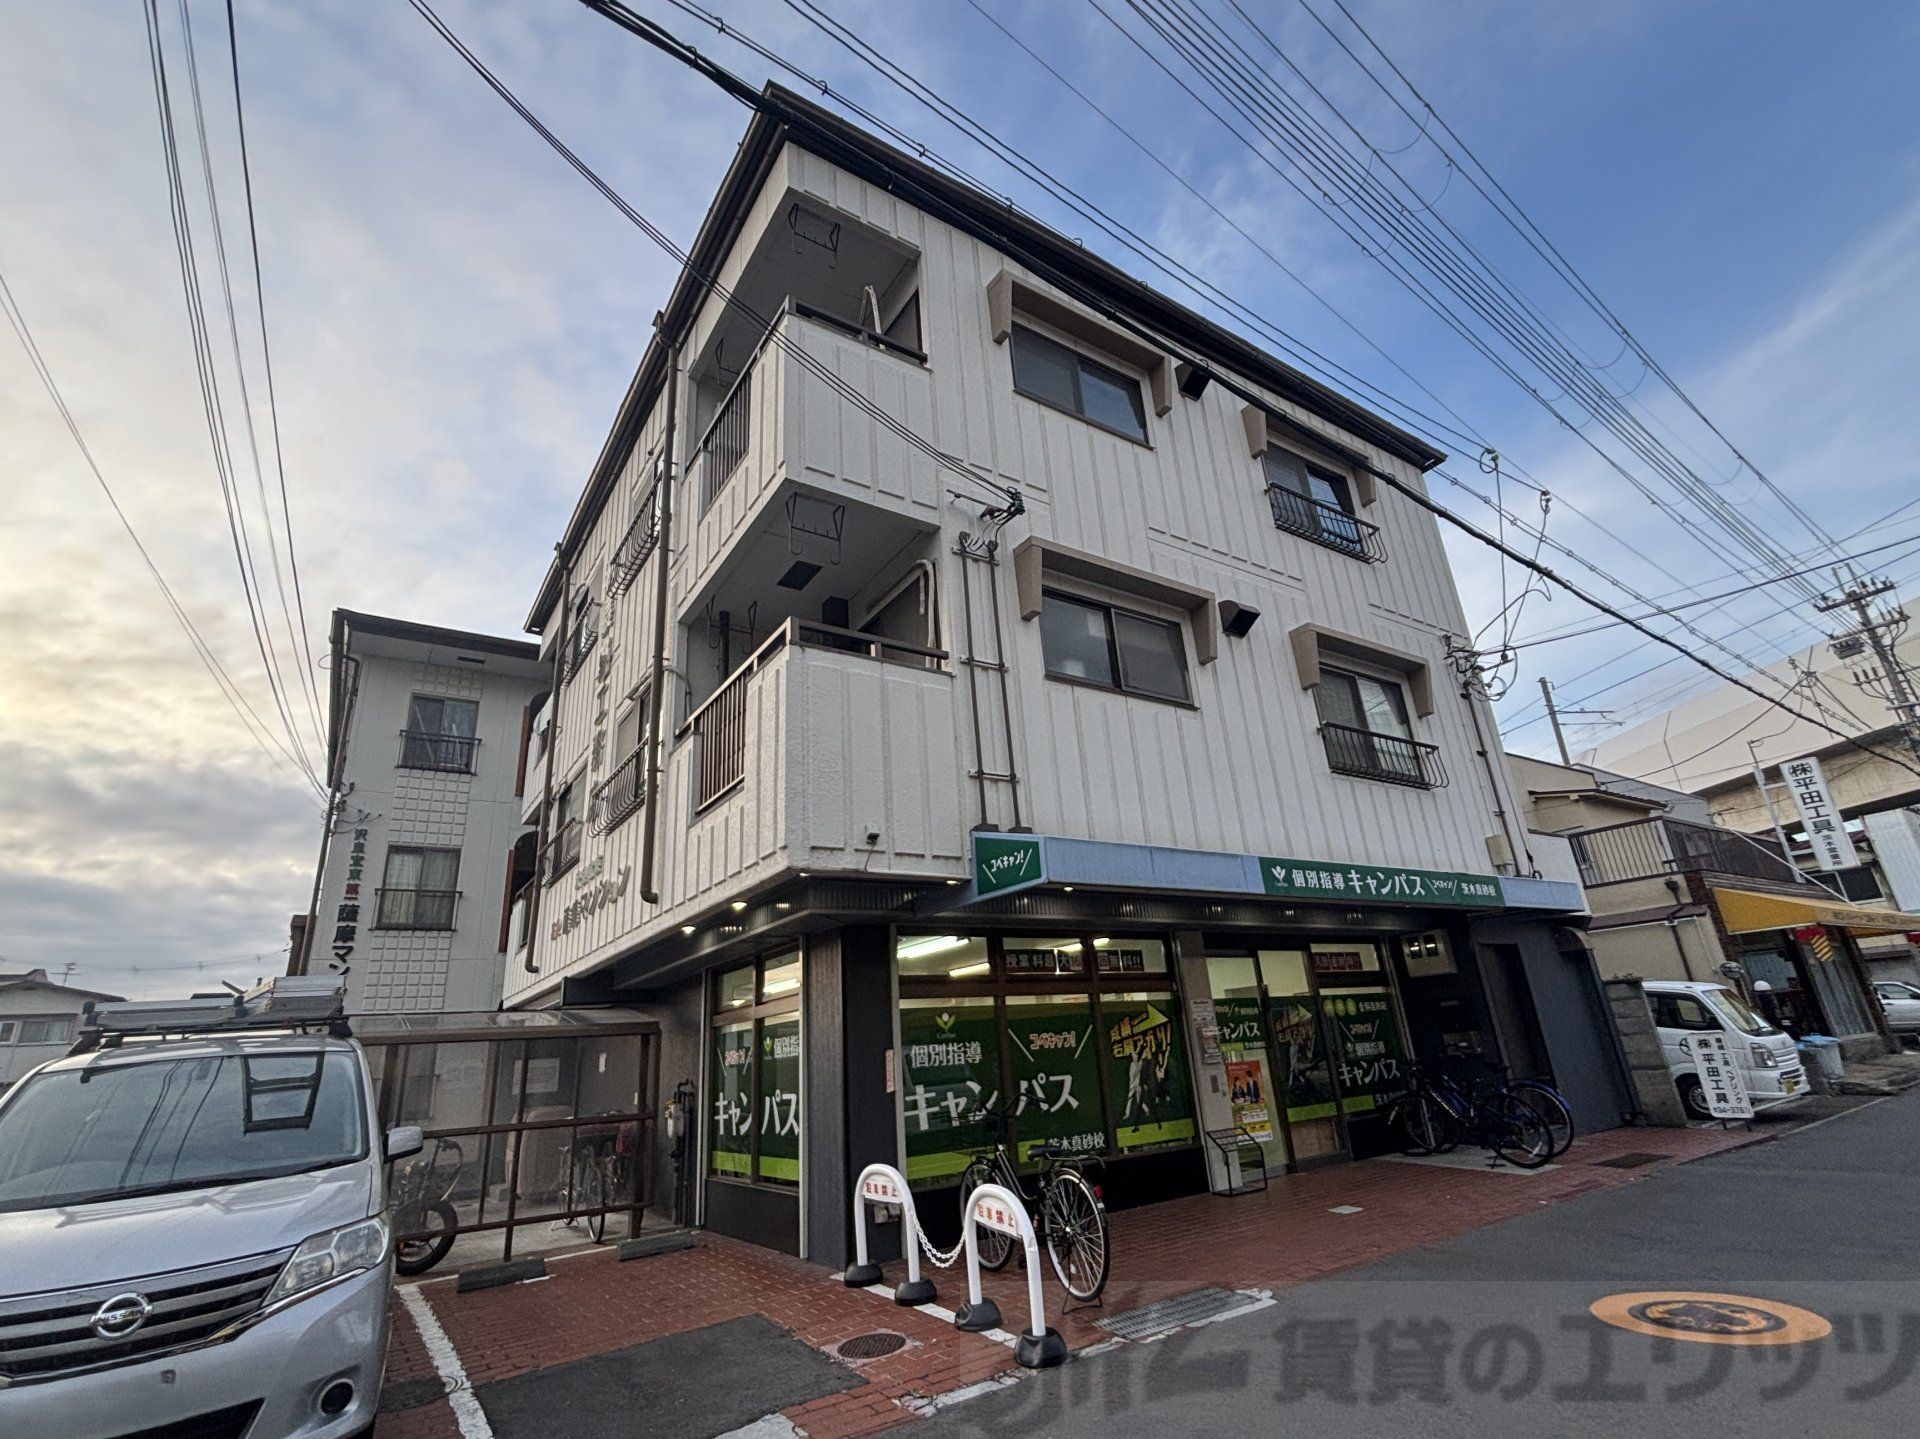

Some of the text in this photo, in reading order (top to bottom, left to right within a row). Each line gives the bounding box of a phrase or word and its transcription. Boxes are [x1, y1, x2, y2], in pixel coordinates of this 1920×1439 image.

[1291, 868, 1346, 890] 個別指導
[1347, 869, 1426, 896] キャンパス
[910, 1041, 983, 1069] 個別指導
[1338, 1058, 1401, 1087] キャンパス
[865, 1181, 898, 1197] 駐車禁止
[977, 1201, 1015, 1227] 駐車禁止
[97, 1308, 146, 1322] NISSAN
